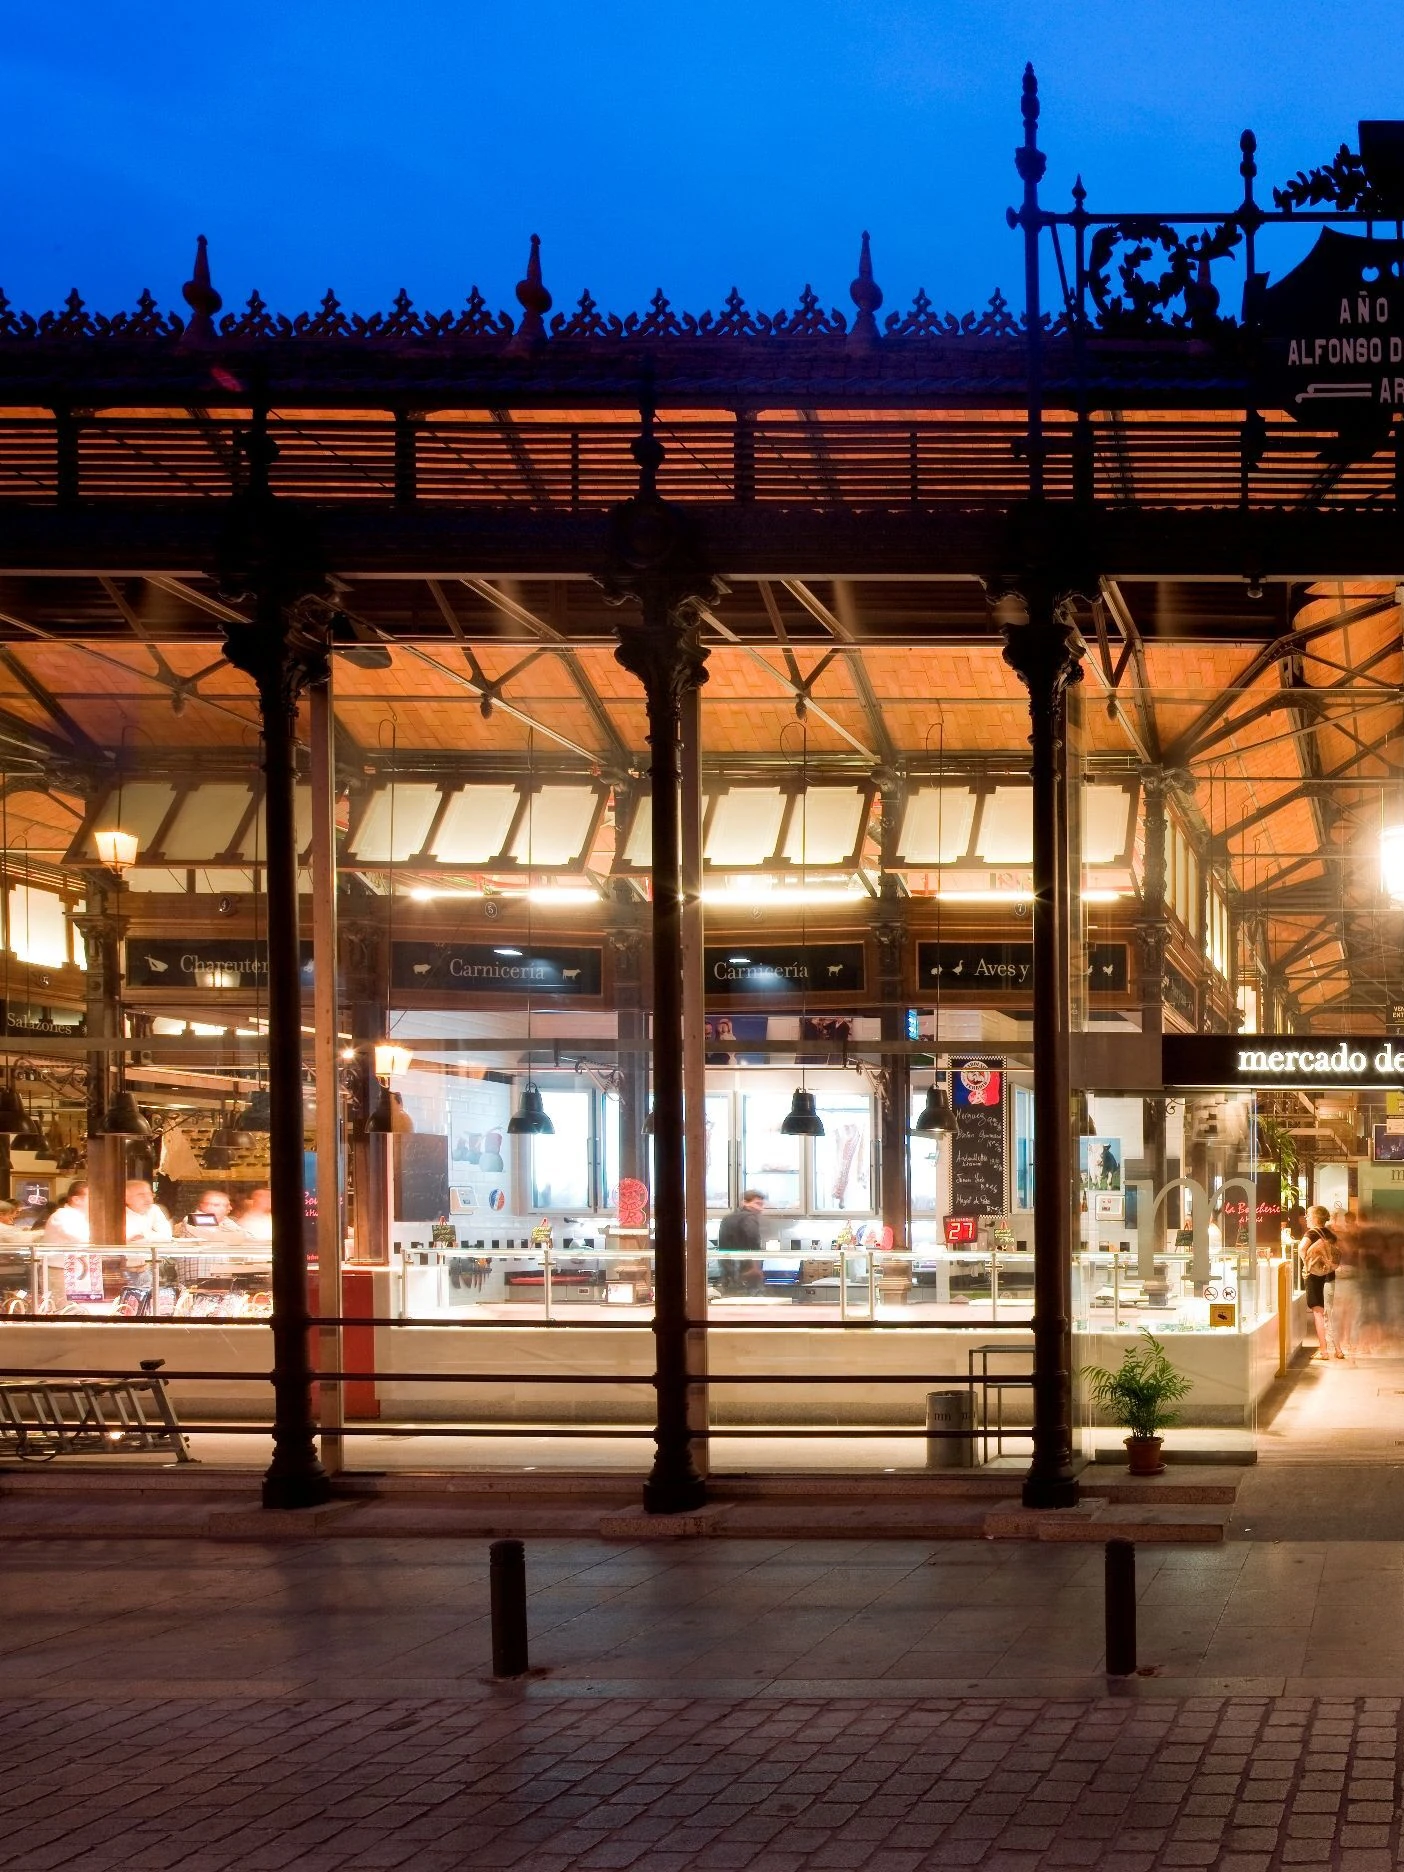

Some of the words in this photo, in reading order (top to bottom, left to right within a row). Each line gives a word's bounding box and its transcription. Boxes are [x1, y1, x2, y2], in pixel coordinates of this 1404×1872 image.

[1339, 290, 1389, 324] AÑO
[1287, 337, 1382, 366] ALFONSO
[180, 954, 268, 974] Charcuter
[449, 957, 545, 981] Carnicería
[713, 961, 809, 981] Carnicería
[974, 957, 1016, 977] Aves
[1018, 963, 1031, 983] y
[6, 1012, 73, 1035] Salazones
[1237, 1042, 1368, 1073] mercado
[1237, 1202, 1281, 1215] Bocherie
[949, 1222, 973, 1240] 27
